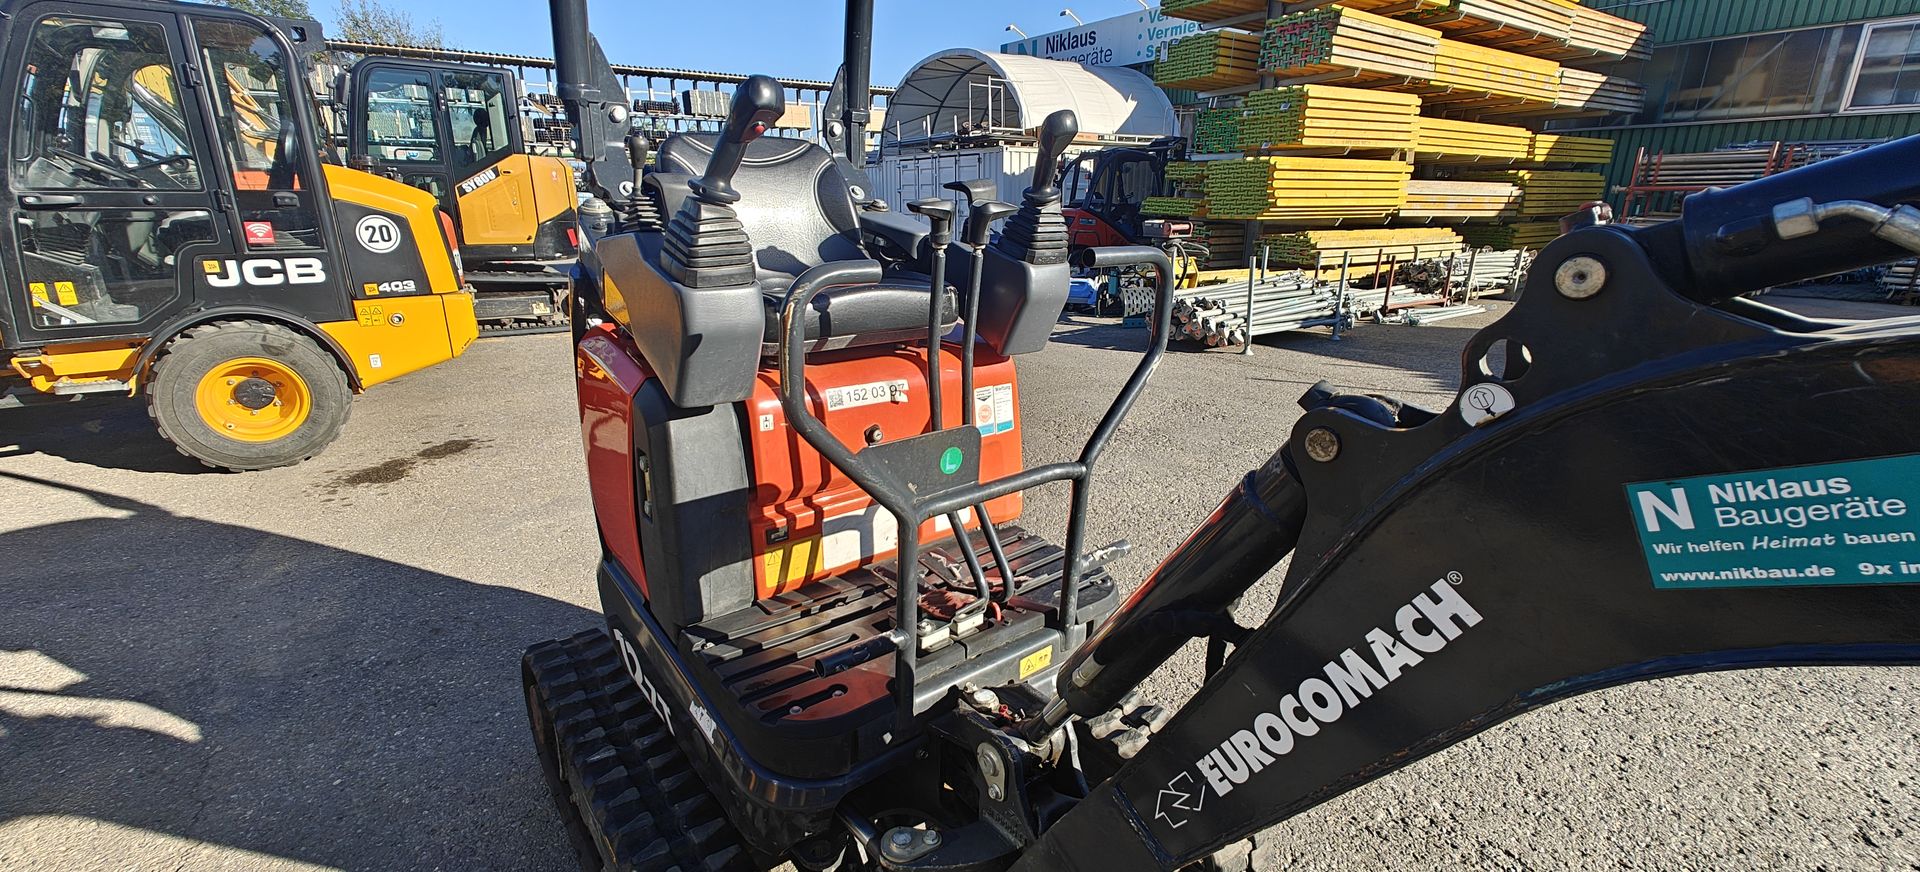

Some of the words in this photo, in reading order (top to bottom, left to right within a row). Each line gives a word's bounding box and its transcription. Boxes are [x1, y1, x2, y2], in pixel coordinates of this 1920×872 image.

[1046, 29, 1097, 54] Niklaus
[461, 169, 496, 193] SY80U
[364, 224, 392, 244] 20
[206, 257, 326, 287] JCB
[379, 280, 416, 292] 403
[846, 388, 868, 402] 152
[871, 386, 885, 399] 03
[1637, 487, 1696, 532] N
[1708, 477, 1852, 505] Niklaus
[1714, 497, 1907, 528] Baugeräte
[1653, 543, 1683, 555] Wir
[1687, 540, 1745, 554] helfen
[1752, 533, 1836, 550] Heimat
[1844, 531, 1916, 546] bauen
[1661, 564, 1836, 582] www.nikbau.de
[1858, 562, 1894, 576] 9x
